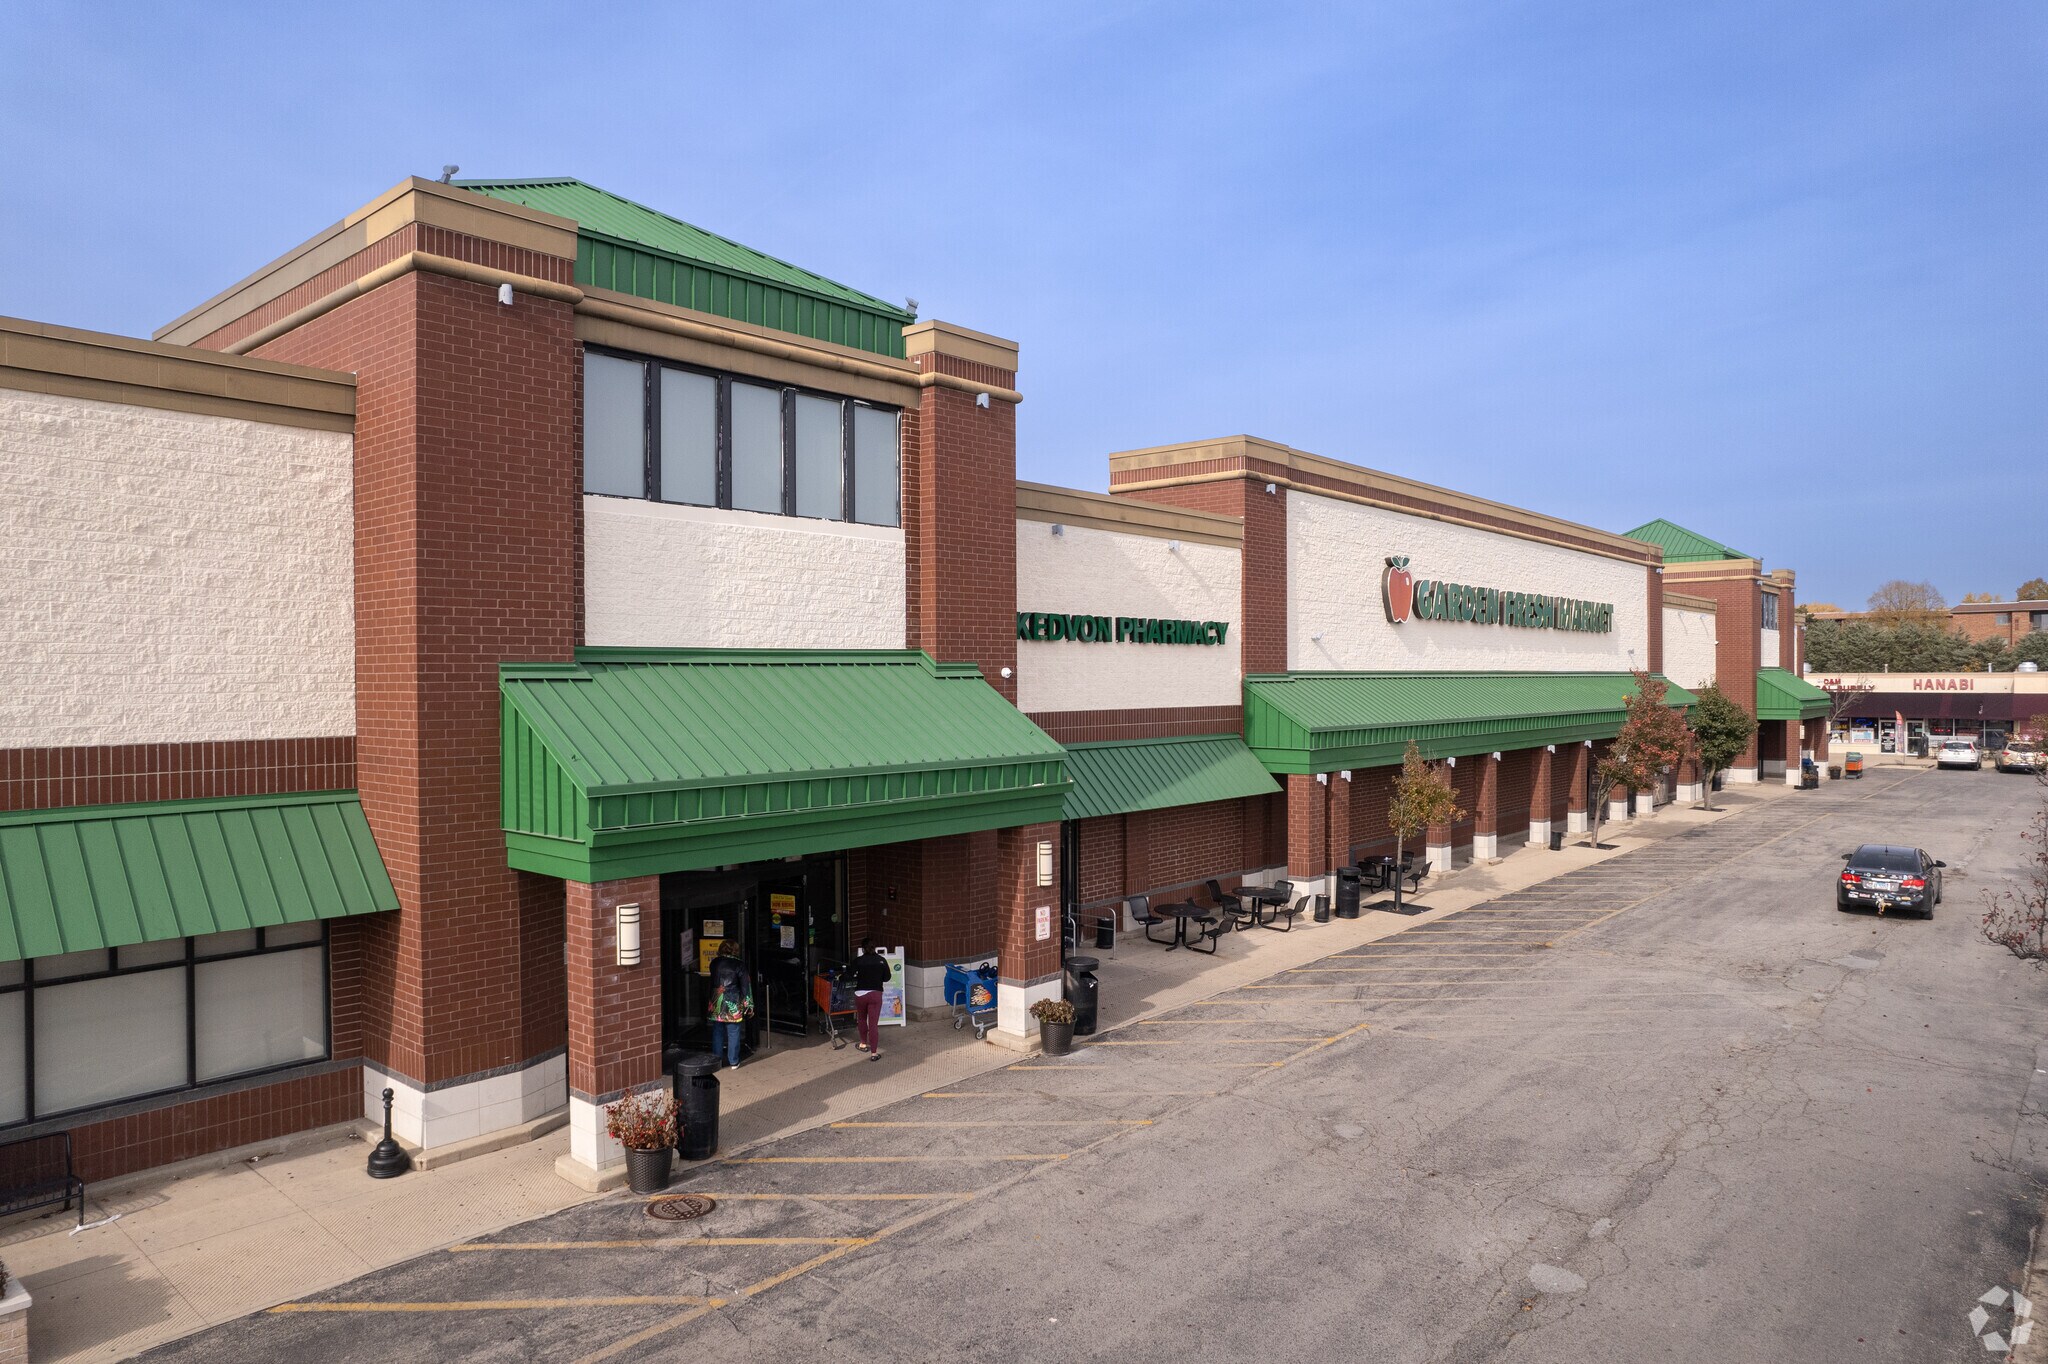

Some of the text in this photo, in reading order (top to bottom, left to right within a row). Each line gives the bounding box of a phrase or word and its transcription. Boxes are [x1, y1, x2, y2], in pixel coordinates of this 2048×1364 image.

[1413, 580, 1614, 633] GARDEN FRESH MARKET
[1017, 611, 1230, 646] KEDVON PHARMACY
[1913, 678, 1974, 691] HANABI
